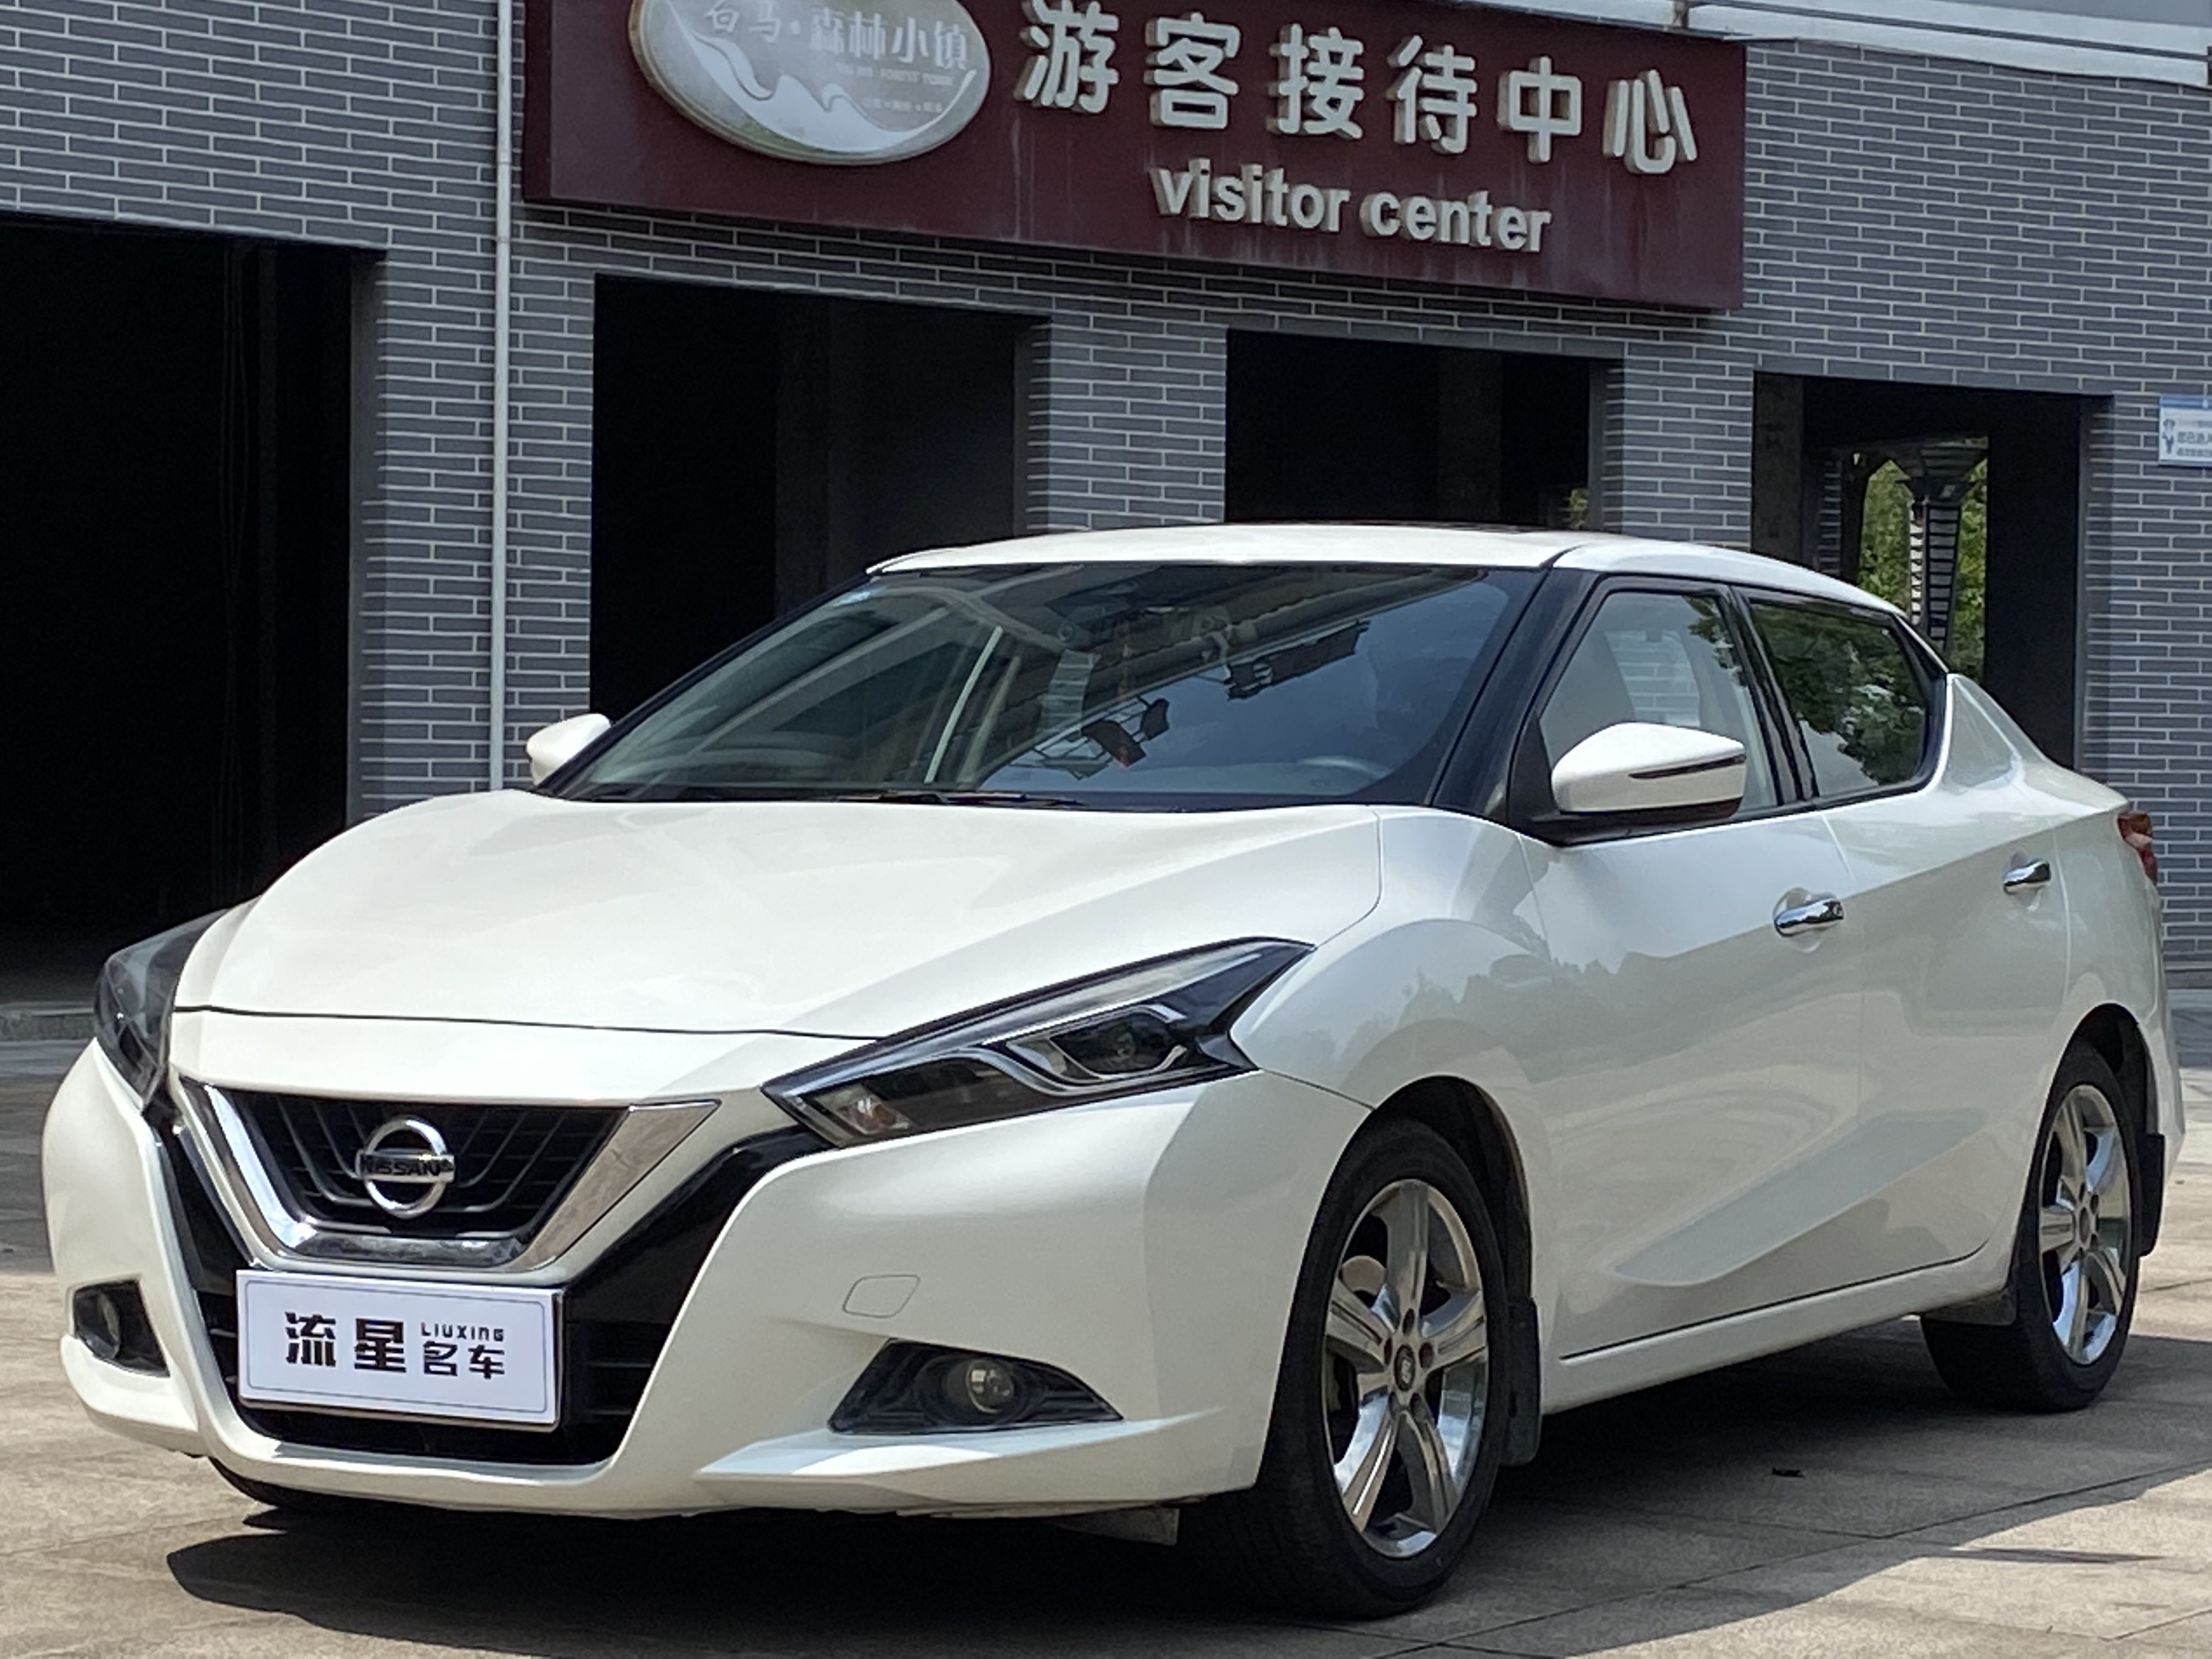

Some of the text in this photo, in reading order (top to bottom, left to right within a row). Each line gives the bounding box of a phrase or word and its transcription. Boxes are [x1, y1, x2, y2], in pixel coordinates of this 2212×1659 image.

[1017, 0, 1697, 173] 游客接待中心
[1150, 157, 1551, 252] visitor center
[420, 1322, 504, 1342] LIUXING
